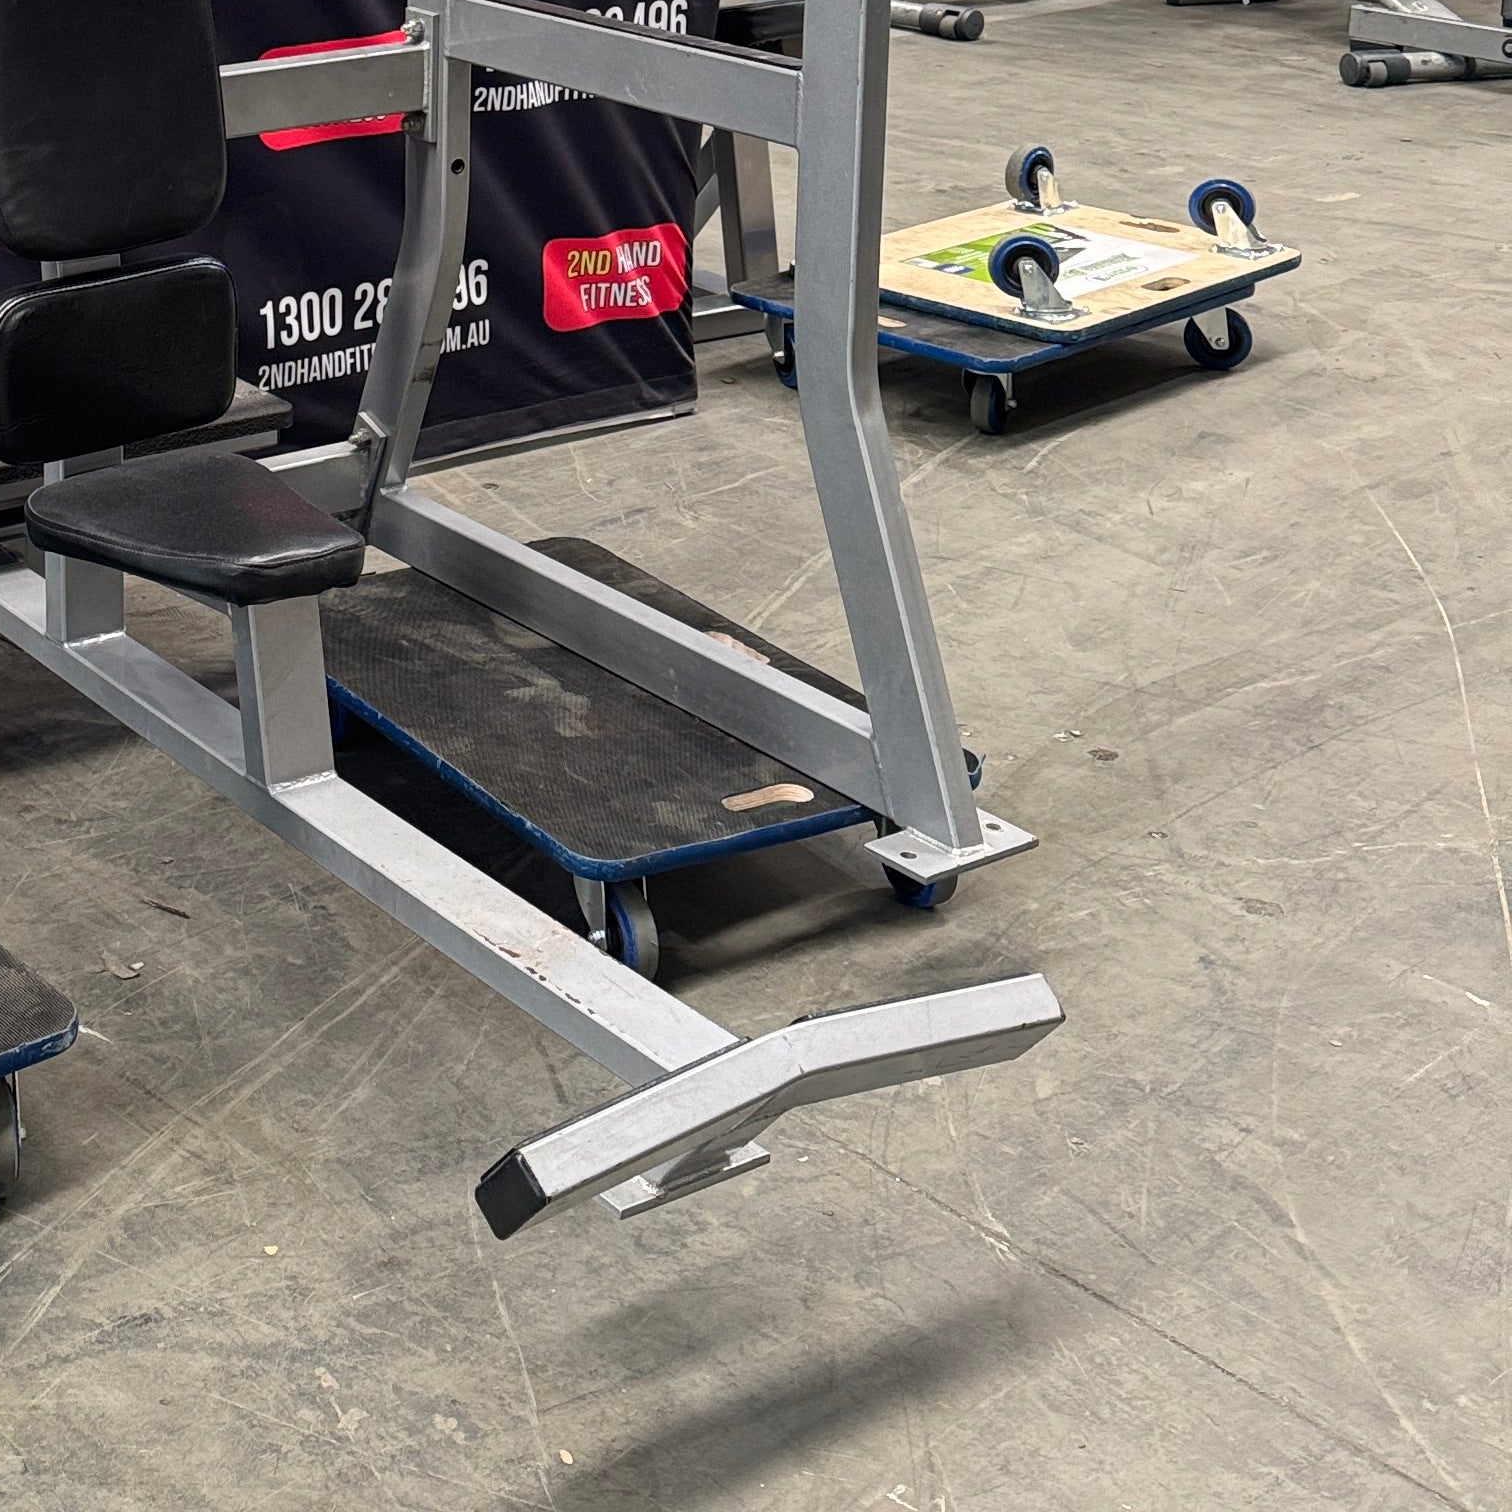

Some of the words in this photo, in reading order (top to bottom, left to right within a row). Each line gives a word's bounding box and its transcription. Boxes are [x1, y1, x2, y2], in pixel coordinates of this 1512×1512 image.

[567, 250, 611, 278] 2ND
[615, 240, 661, 274] HAND
[580, 275, 653, 312] FITNESS
[259, 287, 343, 349] 1300
